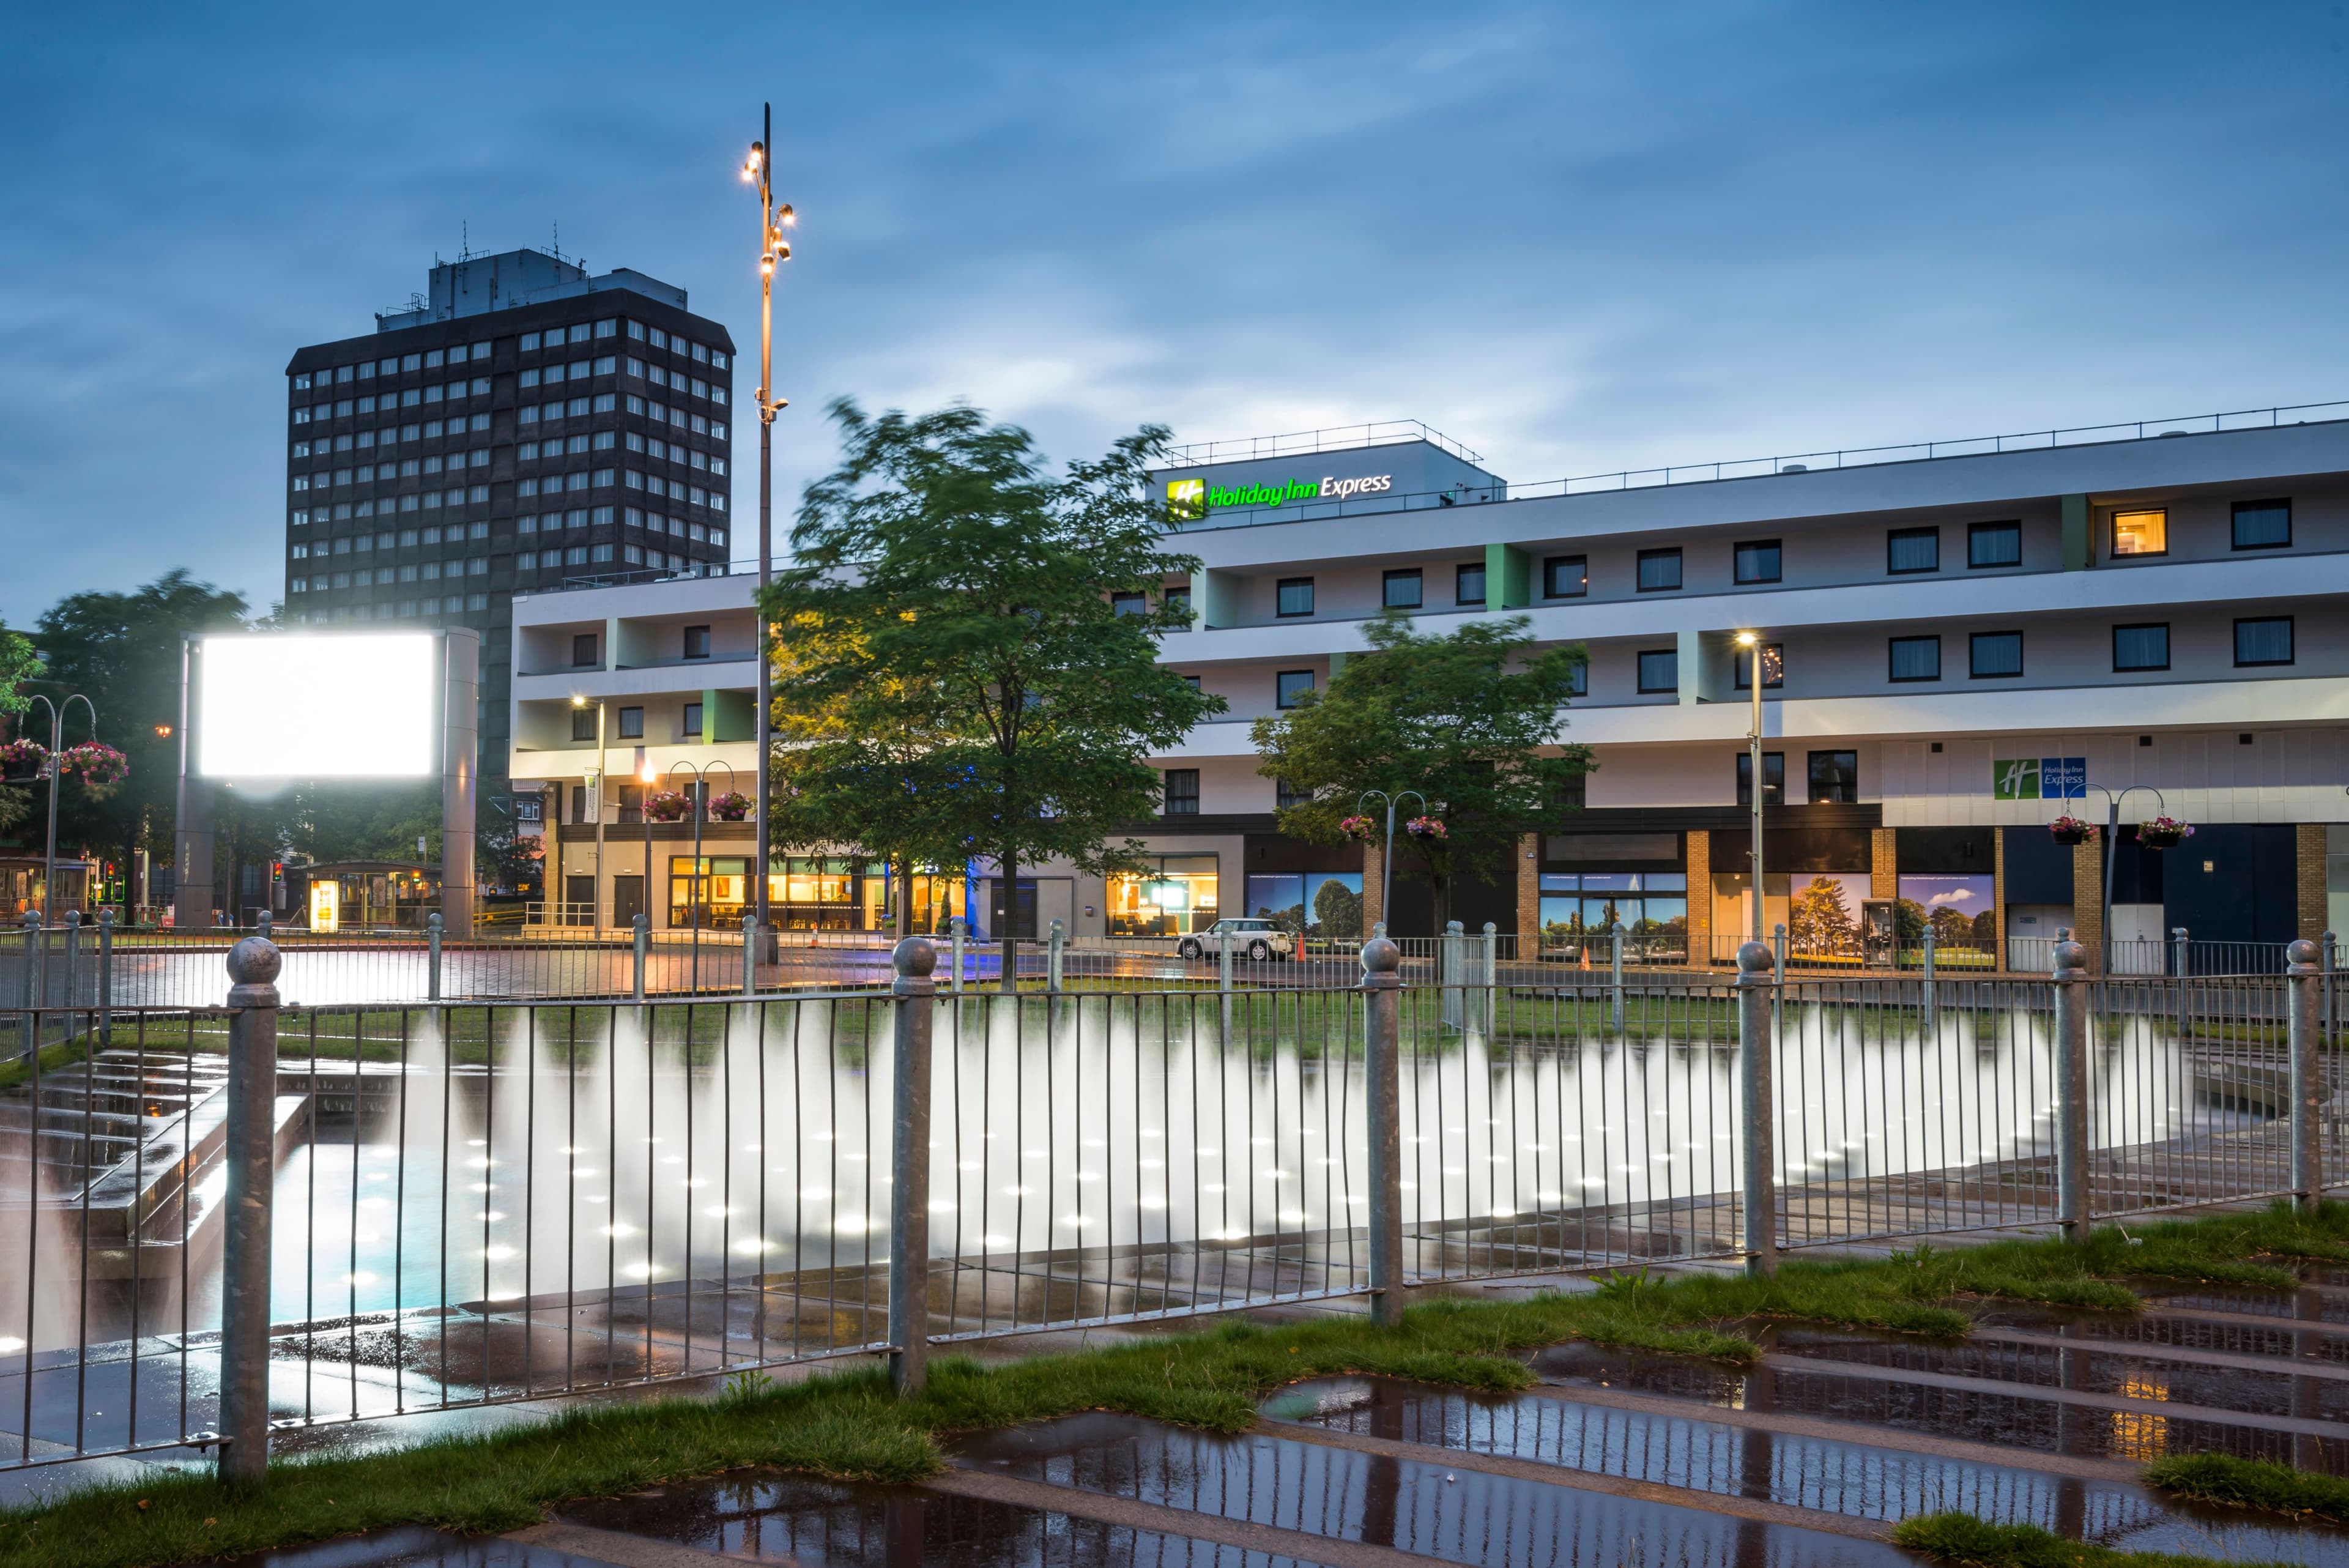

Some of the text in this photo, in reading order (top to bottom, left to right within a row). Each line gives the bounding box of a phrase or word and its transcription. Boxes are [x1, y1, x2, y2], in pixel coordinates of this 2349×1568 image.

[1208, 475, 1391, 507] Holiday Inn Express
[2044, 775, 2084, 786] Express
